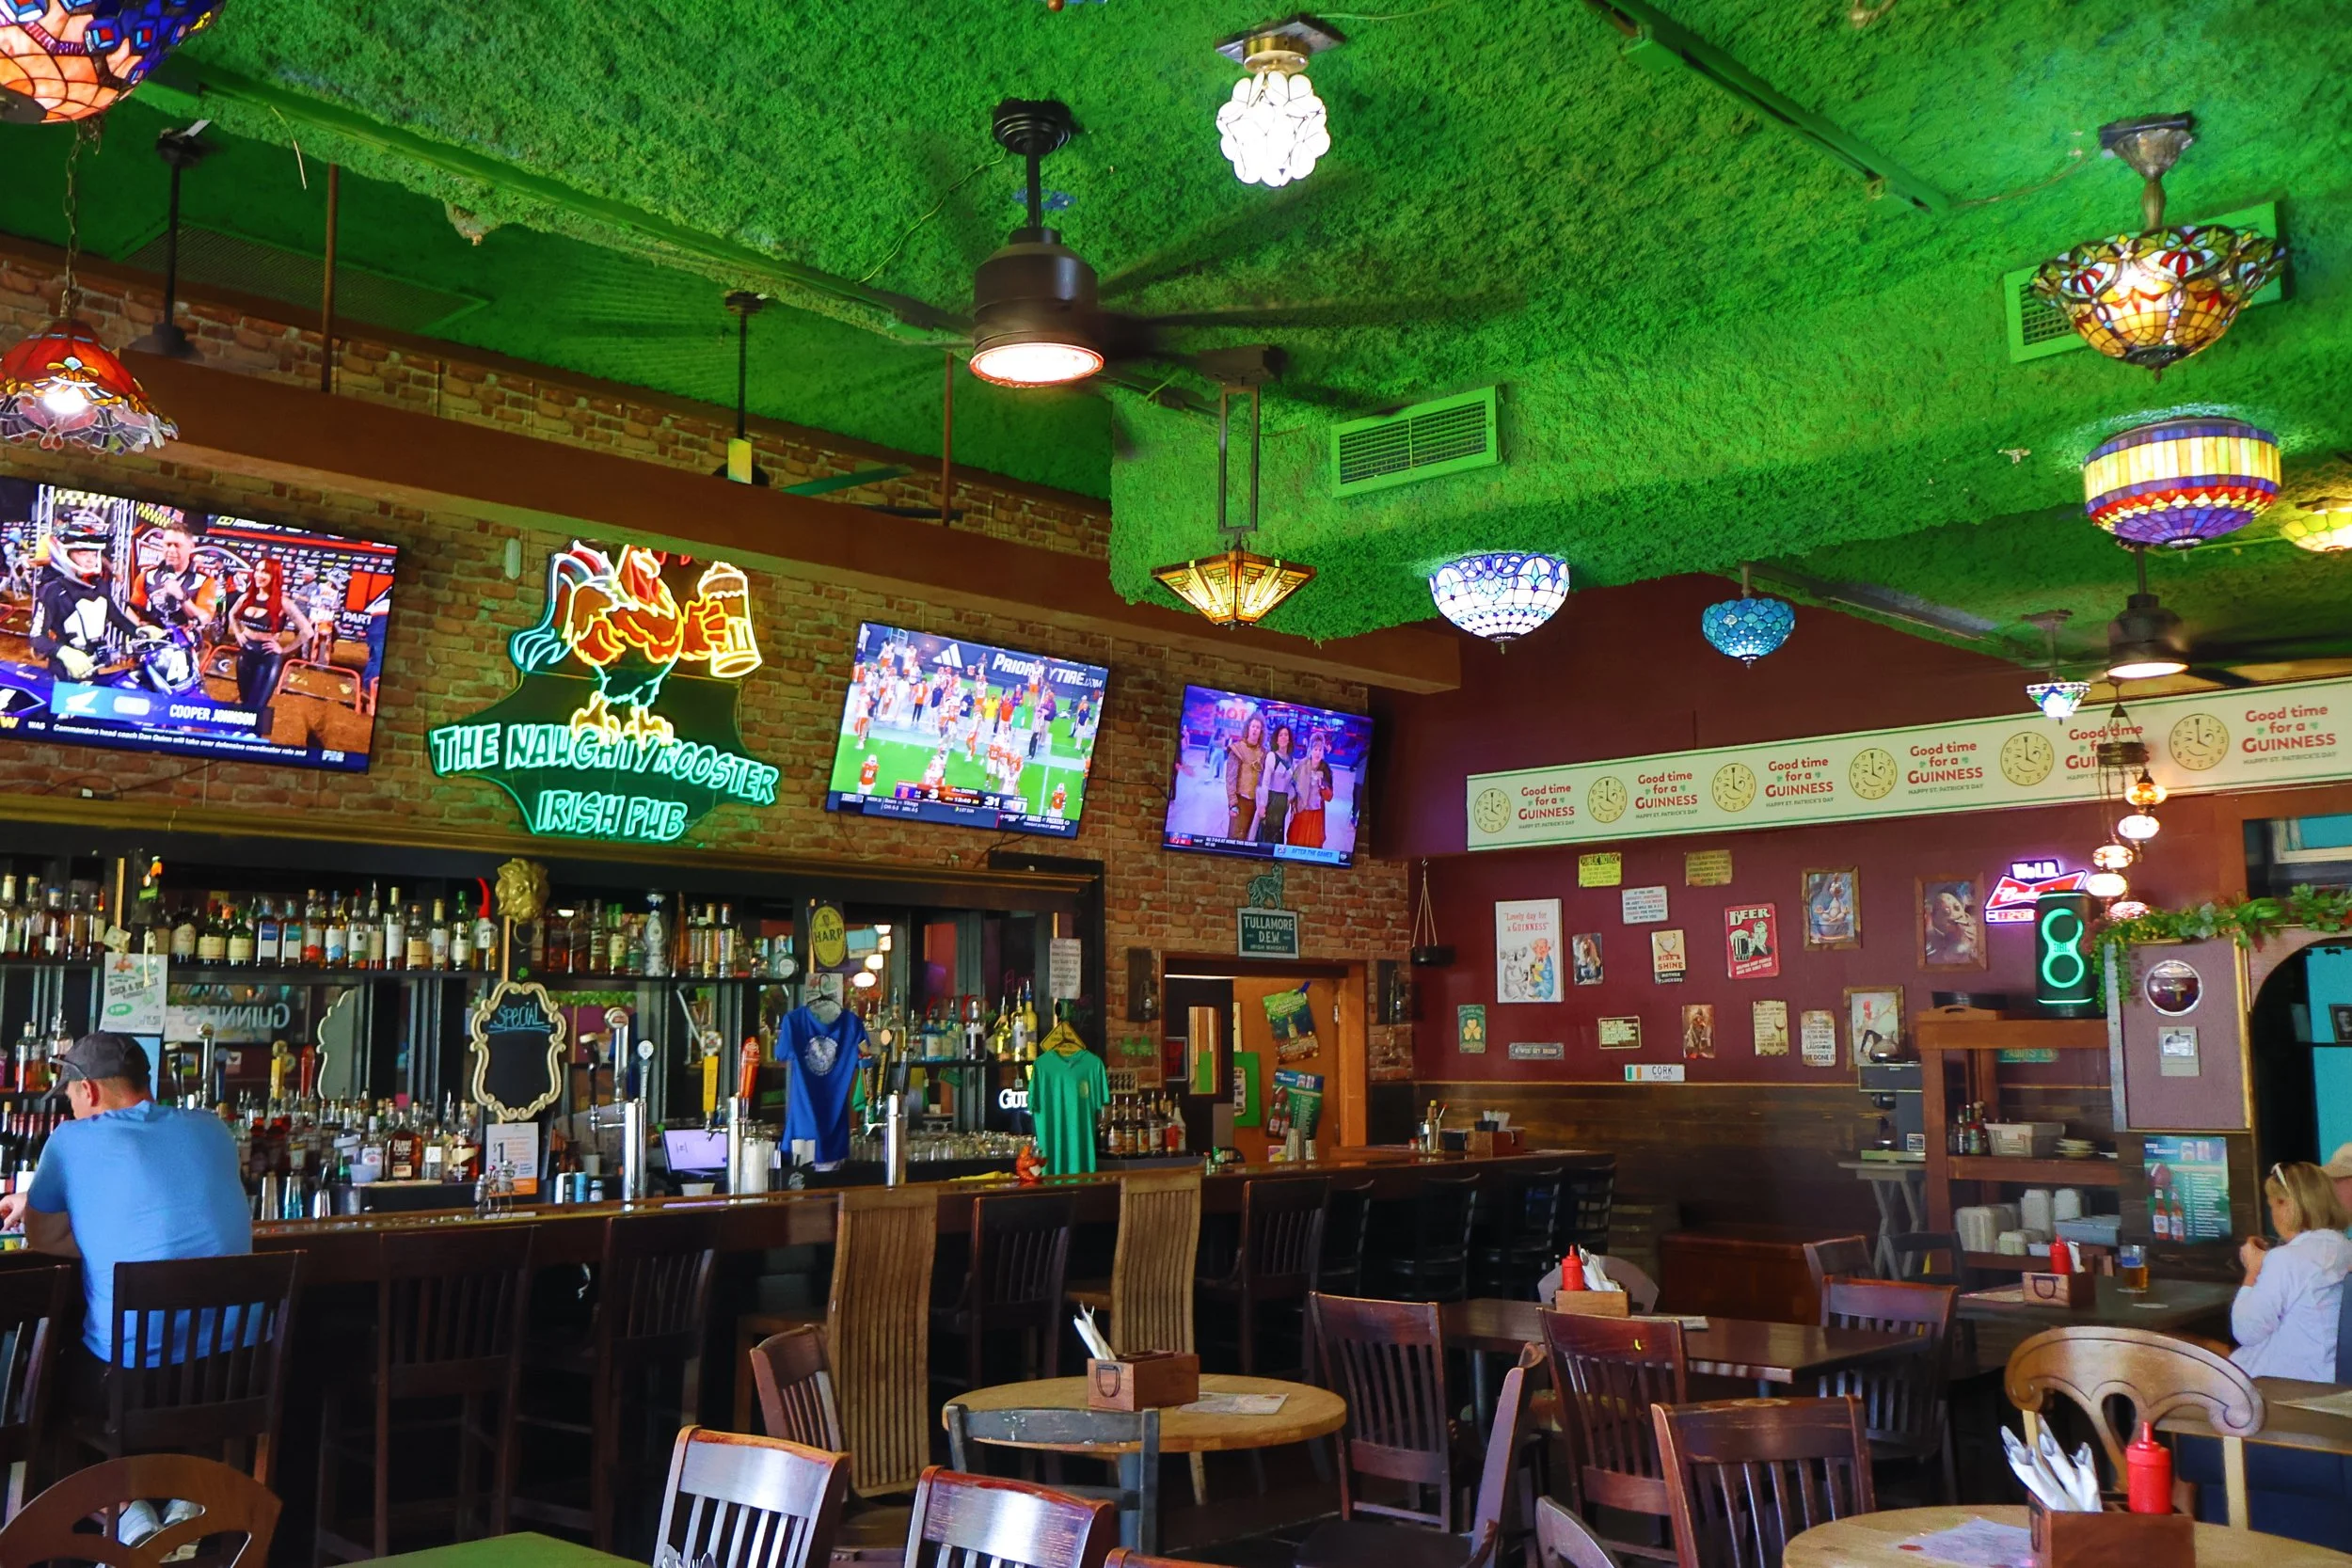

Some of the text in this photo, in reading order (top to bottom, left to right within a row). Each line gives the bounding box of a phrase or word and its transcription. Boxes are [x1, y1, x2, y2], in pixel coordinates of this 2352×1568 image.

[169, 704, 257, 726] COOPER JOHNSON
[2245, 705, 2328, 723] Good time
[2069, 723, 2144, 741] Good time
[2269, 721, 2306, 734] for a
[1910, 741, 1977, 757] Good time
[2242, 733, 2336, 753] GUINNESS
[433, 723, 780, 805] THE NAUGHTY ROOSTER
[1768, 757, 1829, 771] Good time
[1929, 756, 1948, 767] for
[1638, 771, 1692, 784] Good time
[1785, 771, 1802, 782] for
[1907, 767, 1983, 784] GUINNESS
[928, 789, 939, 800] 3
[1521, 784, 1571, 796] Good time
[1653, 784, 1668, 794] for
[1765, 782, 1833, 798] GUINNESS
[984, 795, 1000, 807] 31
[1535, 797, 1549, 806] for
[1635, 794, 1698, 809] GUINNESS
[535, 789, 689, 842] IRISH PUB
[1518, 806, 1575, 820] GUINNESS
[1243, 916, 1293, 931] TULLAMORE
[1526, 912, 1536, 921] day
[1729, 908, 1771, 926] BEER
[814, 928, 843, 943] HARP
[1651, 1066, 1673, 1075] CORK
